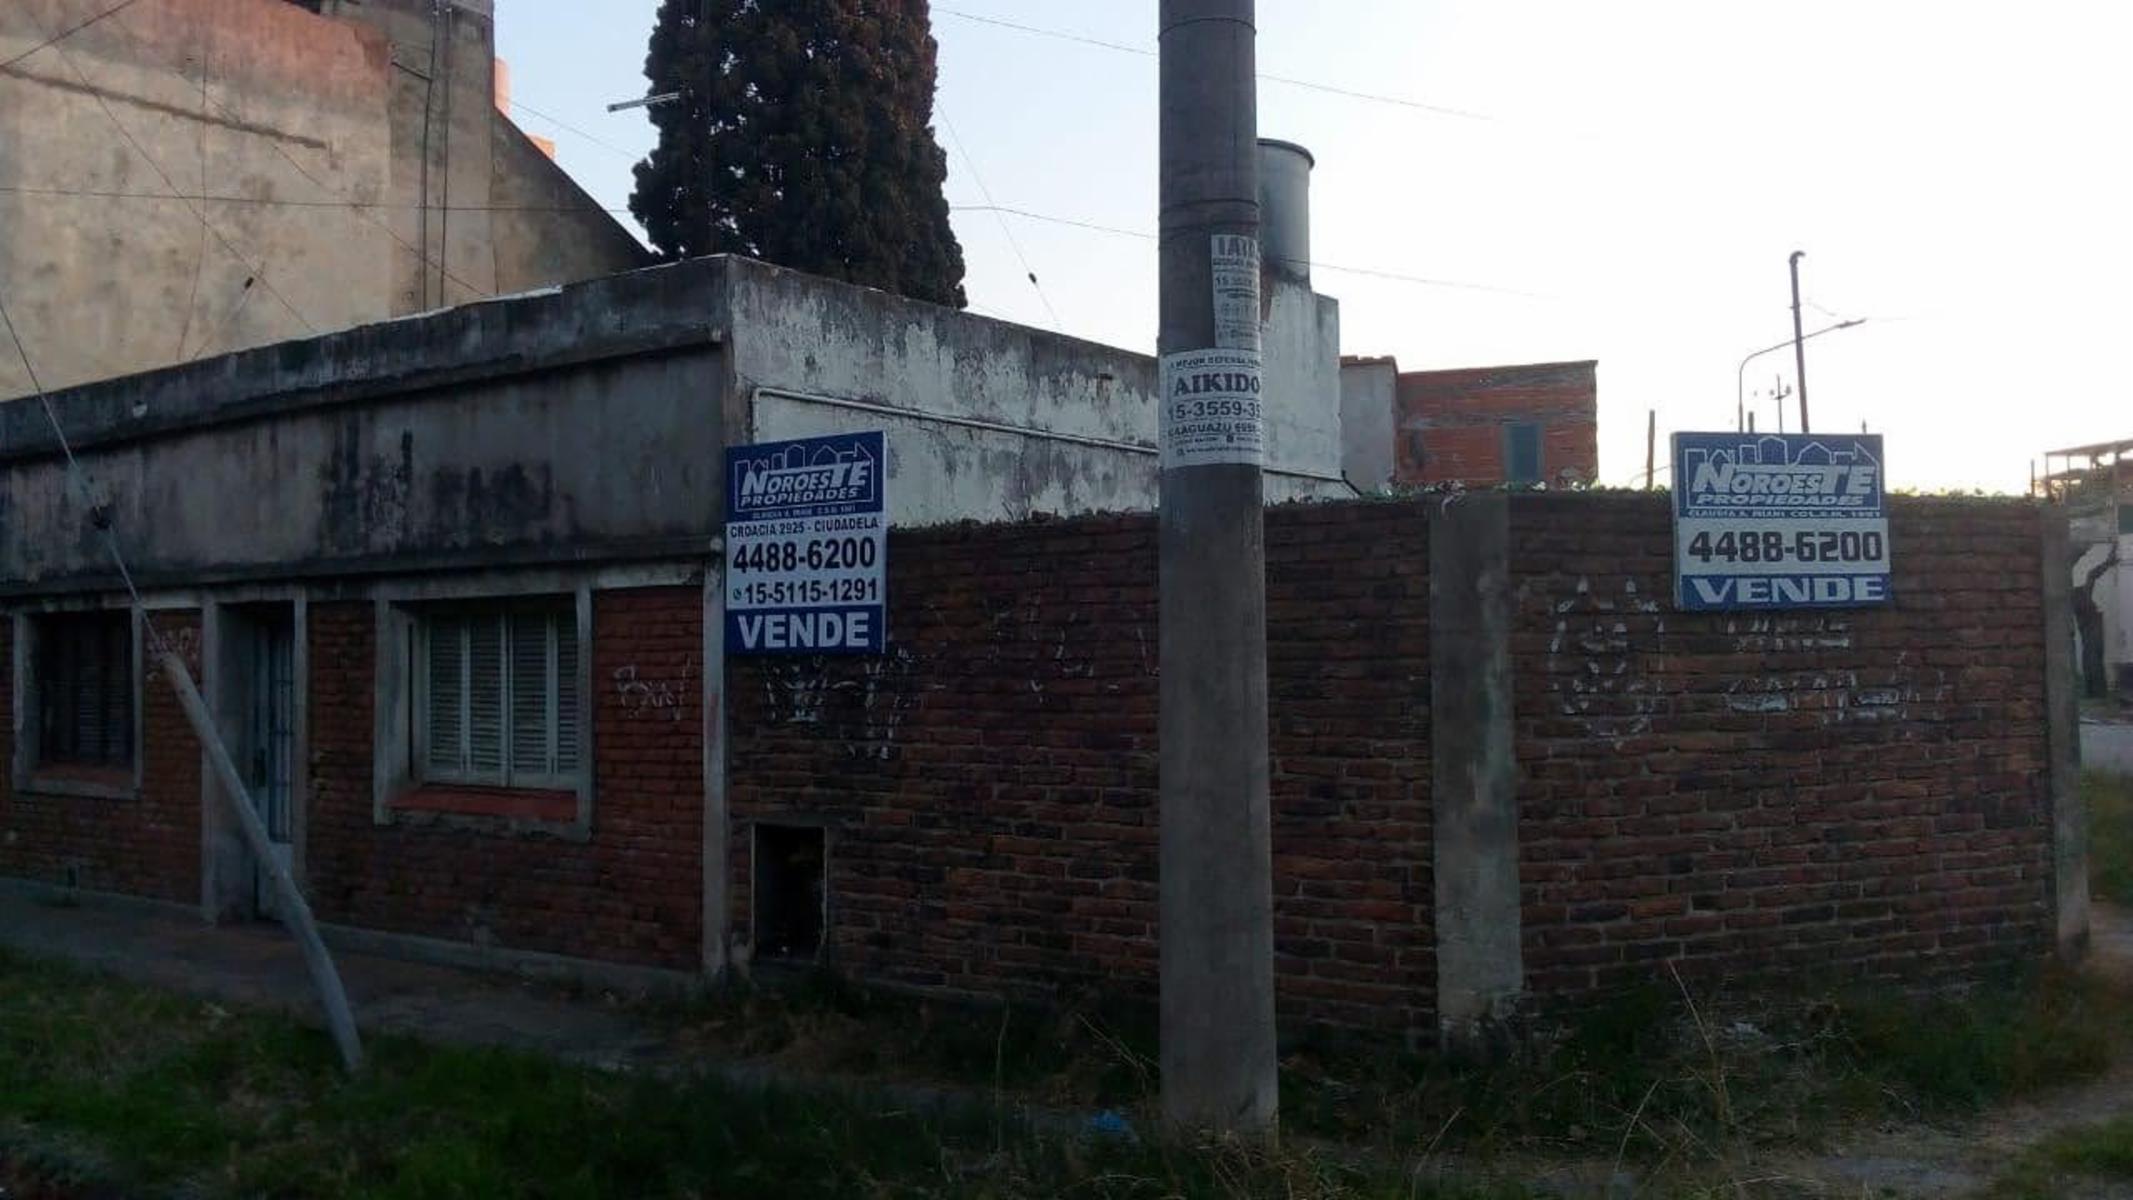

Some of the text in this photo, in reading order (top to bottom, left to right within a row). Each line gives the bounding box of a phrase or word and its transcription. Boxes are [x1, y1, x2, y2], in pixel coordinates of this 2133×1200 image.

[1174, 373, 1260, 396] AIKIDO
[741, 461, 871, 495] NOROESTE
[1692, 463, 1875, 494] NOROESTE
[741, 487, 858, 506] PROPIEDADES
[1696, 495, 1864, 506] PROPIEDADES
[730, 524, 777, 538] CROACIA
[814, 517, 879, 533] CIUDADELA
[733, 537, 876, 573] 4488-6200
[1688, 531, 1883, 563] 4488-6200
[745, 577, 877, 604] 15-5115-1291
[1691, 577, 1885, 603] VENDE
[738, 612, 870, 648] VENDE
